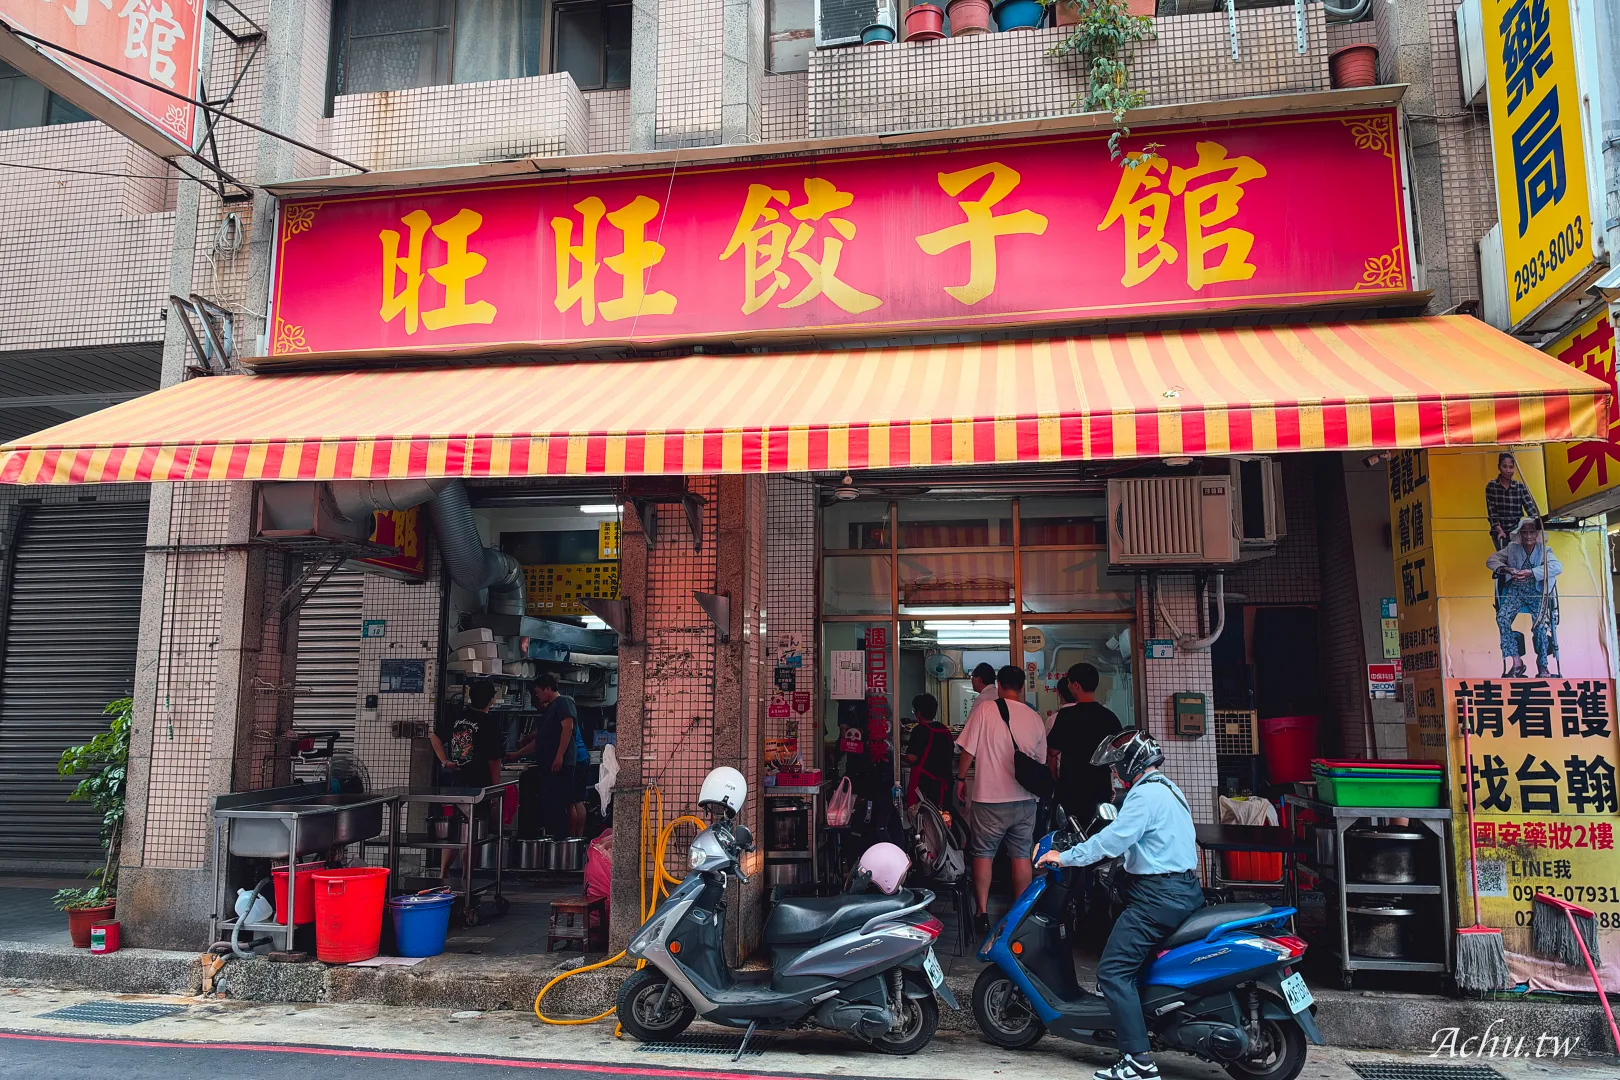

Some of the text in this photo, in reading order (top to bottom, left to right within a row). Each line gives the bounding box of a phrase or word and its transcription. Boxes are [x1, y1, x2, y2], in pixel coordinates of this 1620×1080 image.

[1498, 0, 1567, 239] 藥局
[379, 141, 1267, 336] 旺旺餃子館
[1514, 215, 1584, 303] 2993-8003
[1454, 680, 1612, 739] 請看護
[1460, 753, 1618, 813] 找台翰
[1473, 821, 1615, 850] 國安藥妝2樓
[1511, 859, 1572, 880] LINE我
